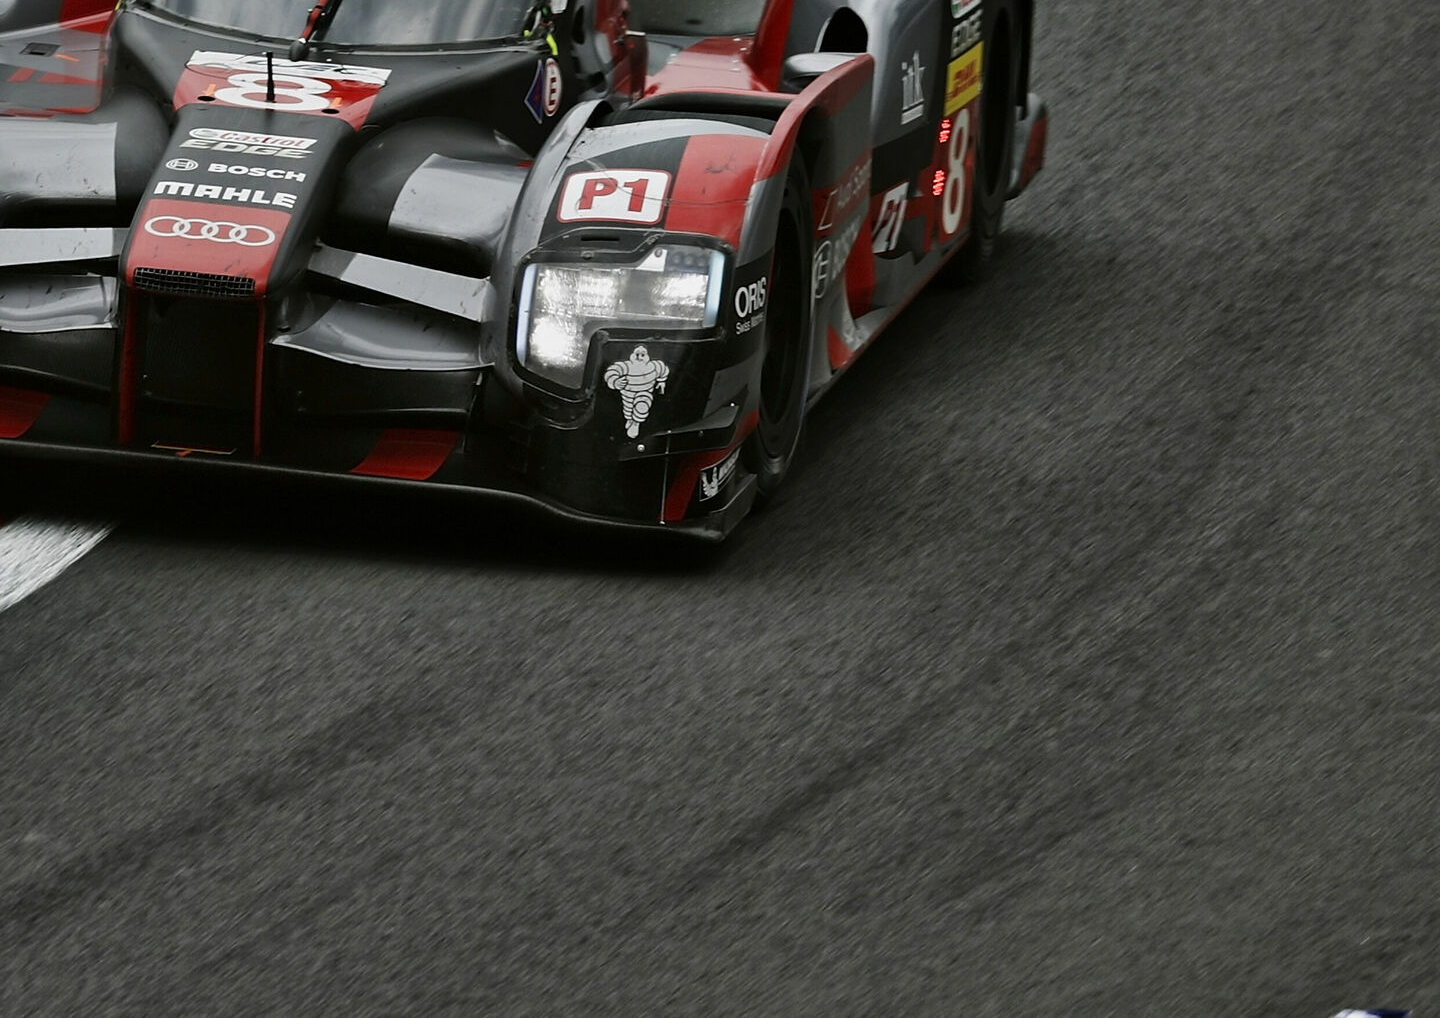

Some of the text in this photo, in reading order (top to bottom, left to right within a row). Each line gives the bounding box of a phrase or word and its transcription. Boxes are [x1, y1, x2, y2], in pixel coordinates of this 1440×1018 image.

[214, 73, 333, 111] 8
[179, 139, 314, 159] EDGE
[220, 131, 310, 147] Castrol
[207, 163, 307, 183] BOSCH
[942, 108, 970, 234] 8
[153, 181, 298, 209] MAHLE
[578, 177, 649, 213] P1
[735, 277, 767, 318] ORIS
